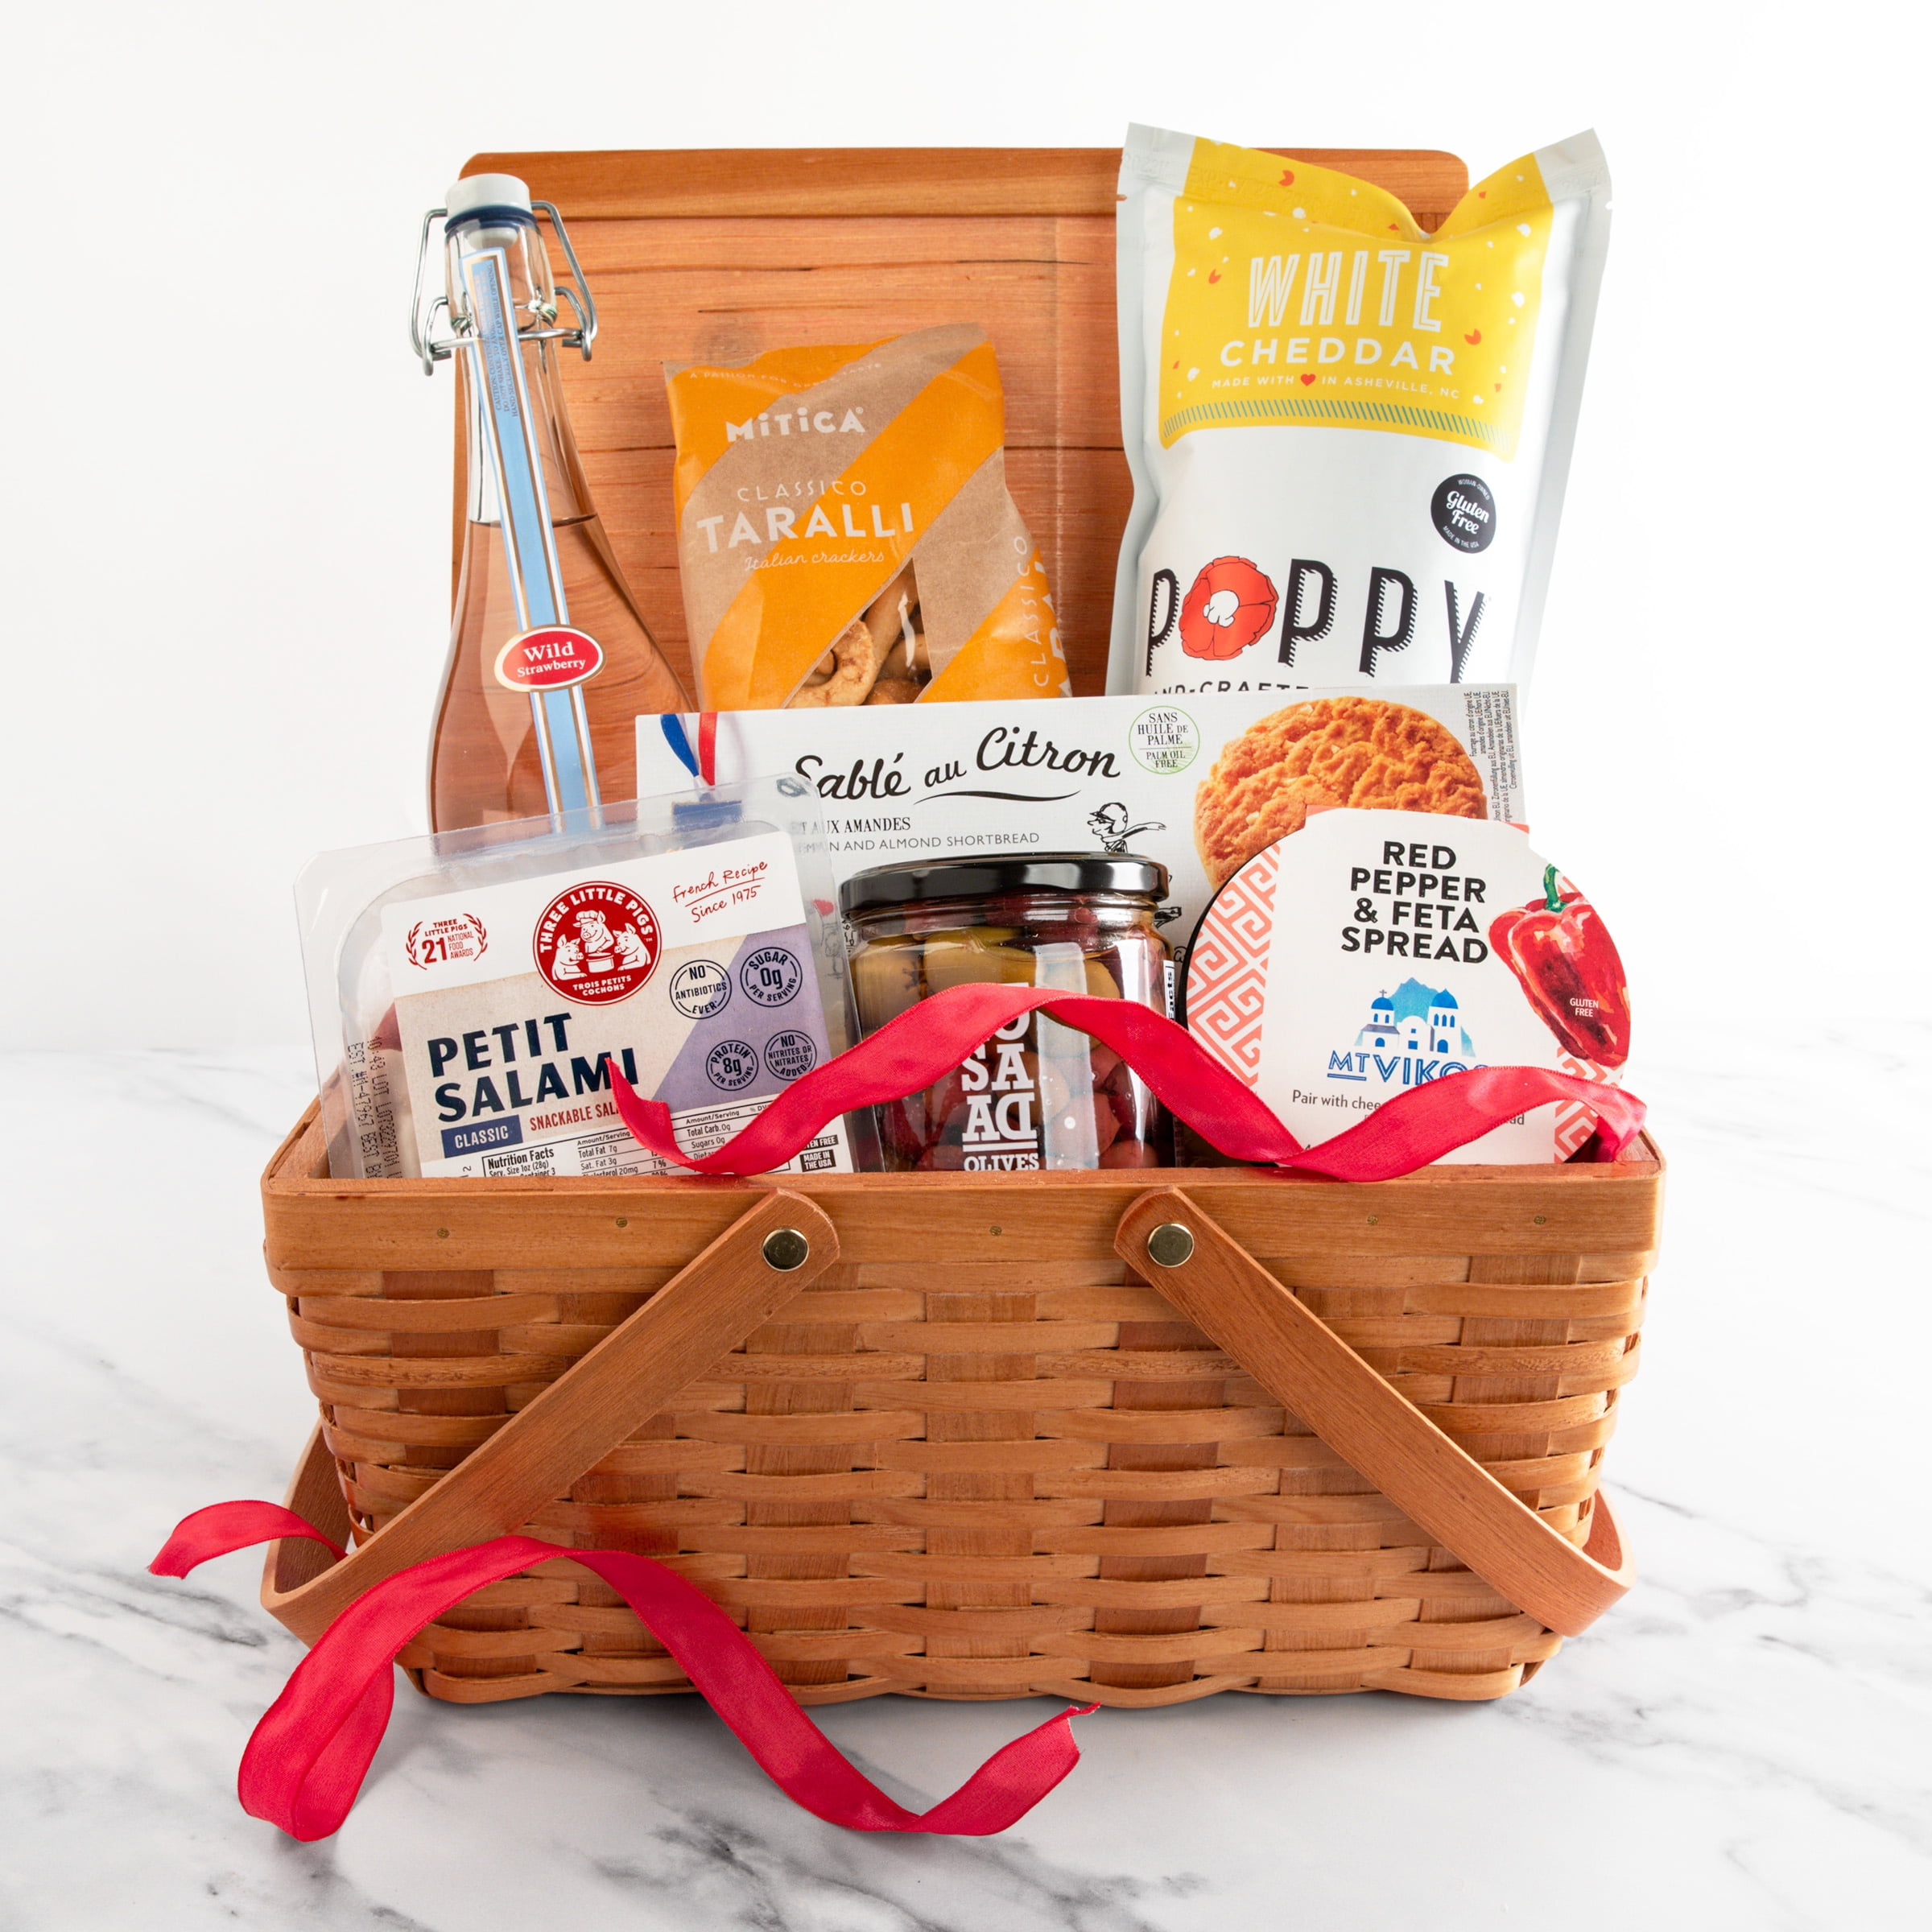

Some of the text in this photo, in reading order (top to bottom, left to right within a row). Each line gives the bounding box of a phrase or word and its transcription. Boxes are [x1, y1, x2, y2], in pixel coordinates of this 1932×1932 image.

[1248, 251, 1449, 332] WHITE
[1220, 338, 1455, 375] CHEDDAR
[1212, 375, 1460, 399] MADE WITH IN ASHEVILLE, NC
[737, 480, 867, 503] CLASSICO
[1446, 490, 1489, 524] Gluten
[696, 502, 914, 554] TARALLI
[1451, 509, 1480, 535] Free
[744, 549, 885, 572] Italian crackers
[1013, 536, 1050, 687] CLASSICO
[1146, 557, 1487, 683] POPPY
[523, 641, 576, 663] Wild
[517, 658, 586, 678] Strawberry
[1149, 712, 1178, 724] SANS
[1137, 724, 1189, 735] HUILE DE
[1147, 734, 1183, 745] PALME
[794, 726, 1121, 800] Sablé au Citron
[1146, 750, 1186, 760] PALM OIL
[1155, 759, 1179, 768] FREE
[844, 816, 911, 833] AMANDES
[844, 839, 875, 852] AND
[879, 836, 942, 850] ALMOND
[946, 832, 1040, 847] SHORTBREAD
[1383, 840, 1457, 870] RED
[673, 861, 768, 902] French Recipe
[1350, 867, 1486, 903] PEPPER
[691, 885, 761, 923] Since 1975
[432, 919, 458, 928] THREE
[539, 887, 654, 953] THREE LITTLE PIGS
[1353, 898, 1480, 933] & FETA
[424, 923, 468, 937] LITTLE PIGS
[448, 931, 474, 943] NATIONAL
[421, 937, 448, 964] 21
[448, 941, 464, 951] FOOD
[450, 947, 474, 960] AWARDS
[1341, 927, 1489, 964] SPREAD
[749, 952, 788, 970] SUGAR
[688, 964, 706, 980] NO
[760, 968, 782, 989] 0g
[572, 975, 632, 991] TROIS PETITS
[582, 984, 625, 997] COCHONS
[675, 981, 728, 1000] ANTIBIOTICS
[749, 977, 797, 1001] PER SERVING
[1569, 997, 1600, 1009] GLUTEN
[1575, 1007, 1594, 1018] FREE
[427, 1012, 572, 1078] PETIT
[780, 1034, 795, 1047] NO
[711, 1043, 751, 1064] PROTEIN
[768, 1045, 812, 1059] NITRITES OR
[774, 1055, 809, 1067] NITRATES
[722, 1057, 742, 1076] 8g
[1373, 1054, 1488, 1086] VIKO
[435, 1047, 638, 1122] SALAMI
[713, 1066, 753, 1087] PER SERVING
[1292, 1089, 1381, 1111] Pair with chee
[529, 1105, 593, 1132] SNACKABLE
[686, 1110, 740, 1125] Amount/Serving
[453, 1125, 510, 1150] CLASSIC
[576, 1130, 630, 1146] Amount/Serving
[687, 1128, 704, 1137] Total
[704, 1125, 722, 1133] Carb.
[691, 1139, 715, 1150] Sugars
[819, 1136, 836, 1146] FREE
[488, 1147, 555, 1170] Nutrition Facts
[578, 1145, 617, 1159] Total Fat 7g
[803, 1150, 831, 1162] MADE IN
[964, 1152, 1039, 1171] OLIVES
[506, 1166, 520, 1175] Size
[532, 1160, 549, 1170] (28g)
[580, 1158, 617, 1171] Sat. Fat 3g
[618, 1166, 638, 1175] 20mg
[804, 1158, 832, 1170] THE USA
